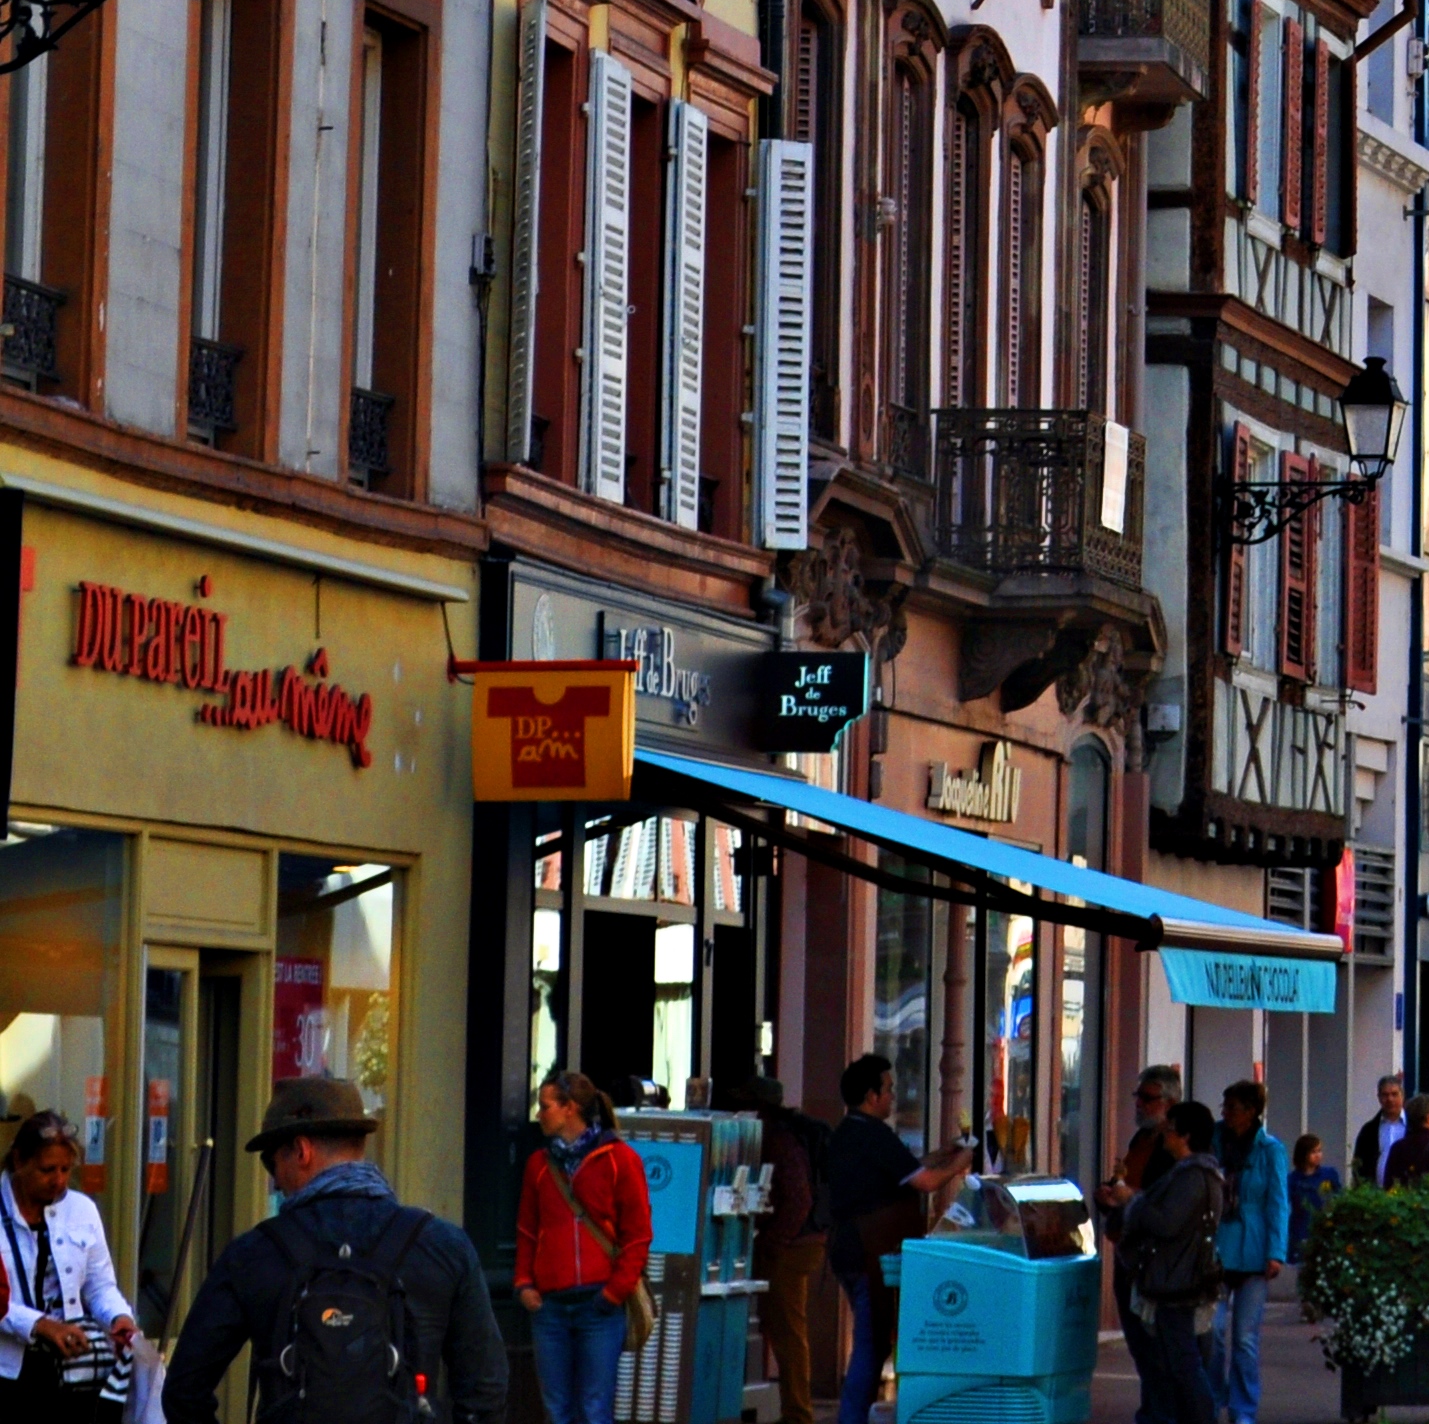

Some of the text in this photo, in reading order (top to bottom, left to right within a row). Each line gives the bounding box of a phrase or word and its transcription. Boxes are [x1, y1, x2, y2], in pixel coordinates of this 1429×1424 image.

[795, 666, 833, 687] Jeff
[805, 687, 821, 700] de
[779, 695, 848, 723] Bruges
